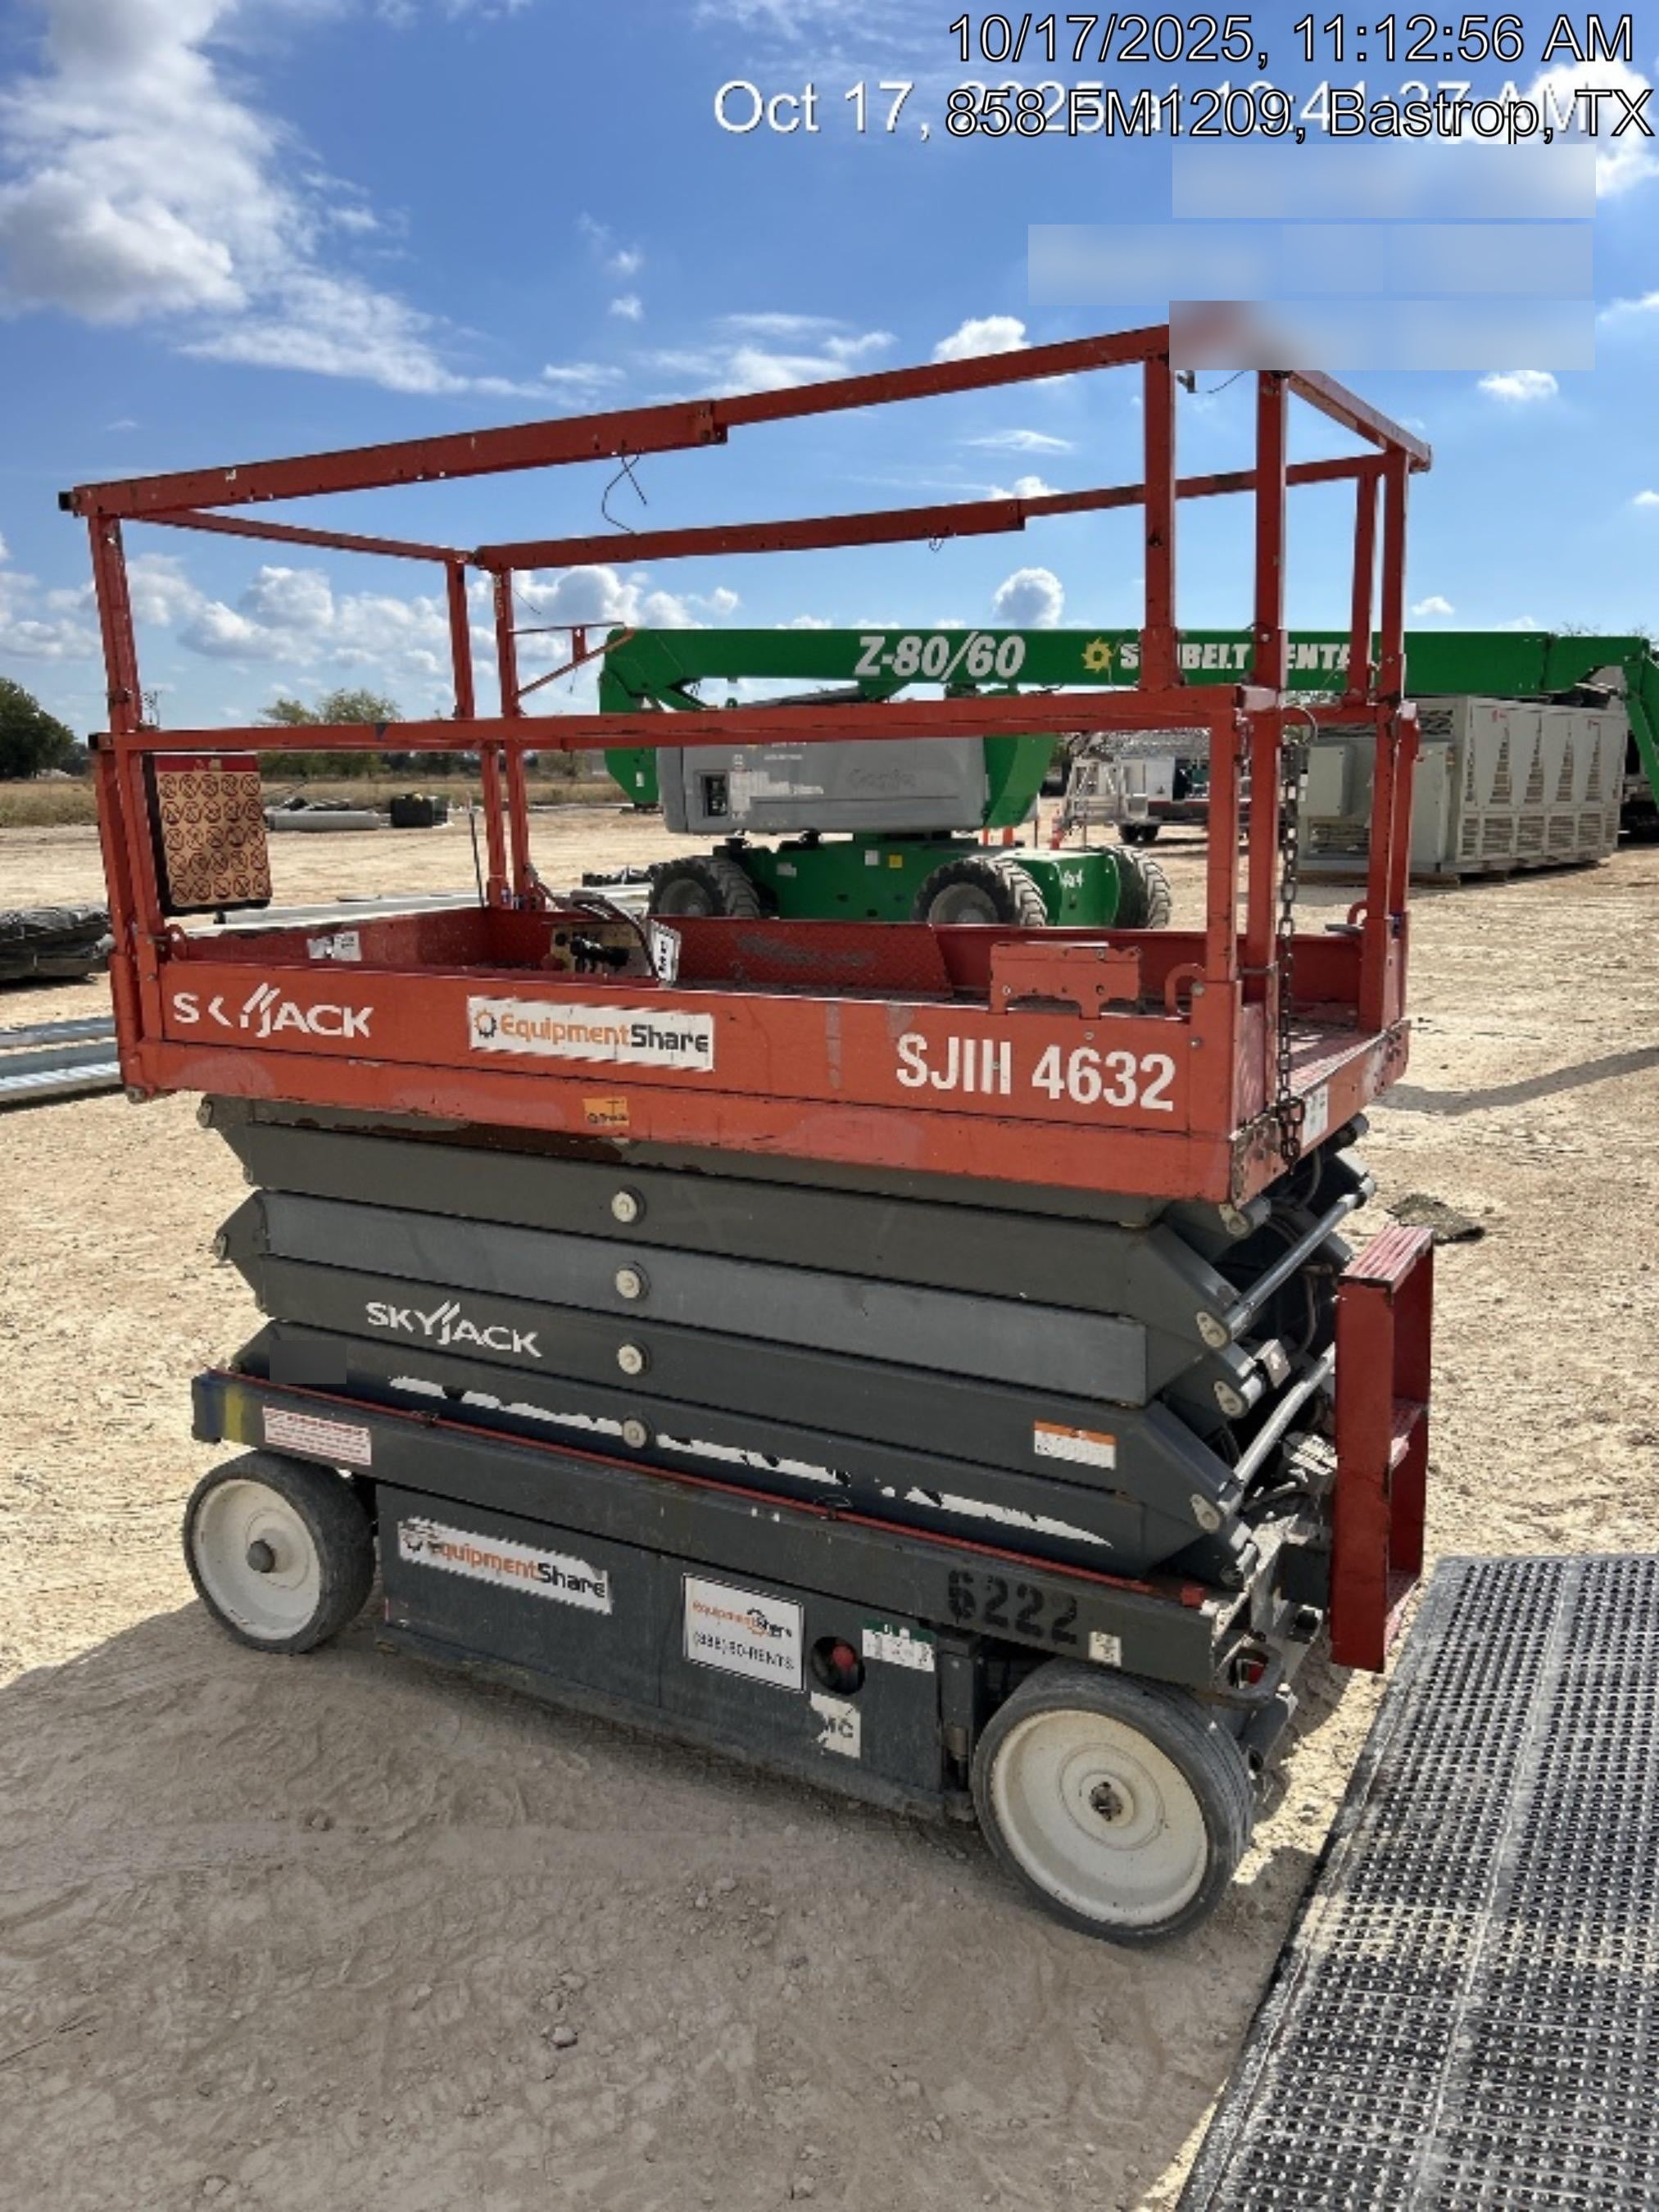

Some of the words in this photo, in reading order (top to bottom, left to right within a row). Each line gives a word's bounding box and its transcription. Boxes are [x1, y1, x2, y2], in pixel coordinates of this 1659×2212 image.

[854, 631, 1026, 682] Z-80/60
[1119, 643, 1252, 670] SBELT
[500, 1013, 709, 1054] EquipmentShare
[1031, 1043, 1177, 1113] 4632
[365, 1299, 543, 1358] SKYJACK
[948, 1569, 1078, 1645] 6222
